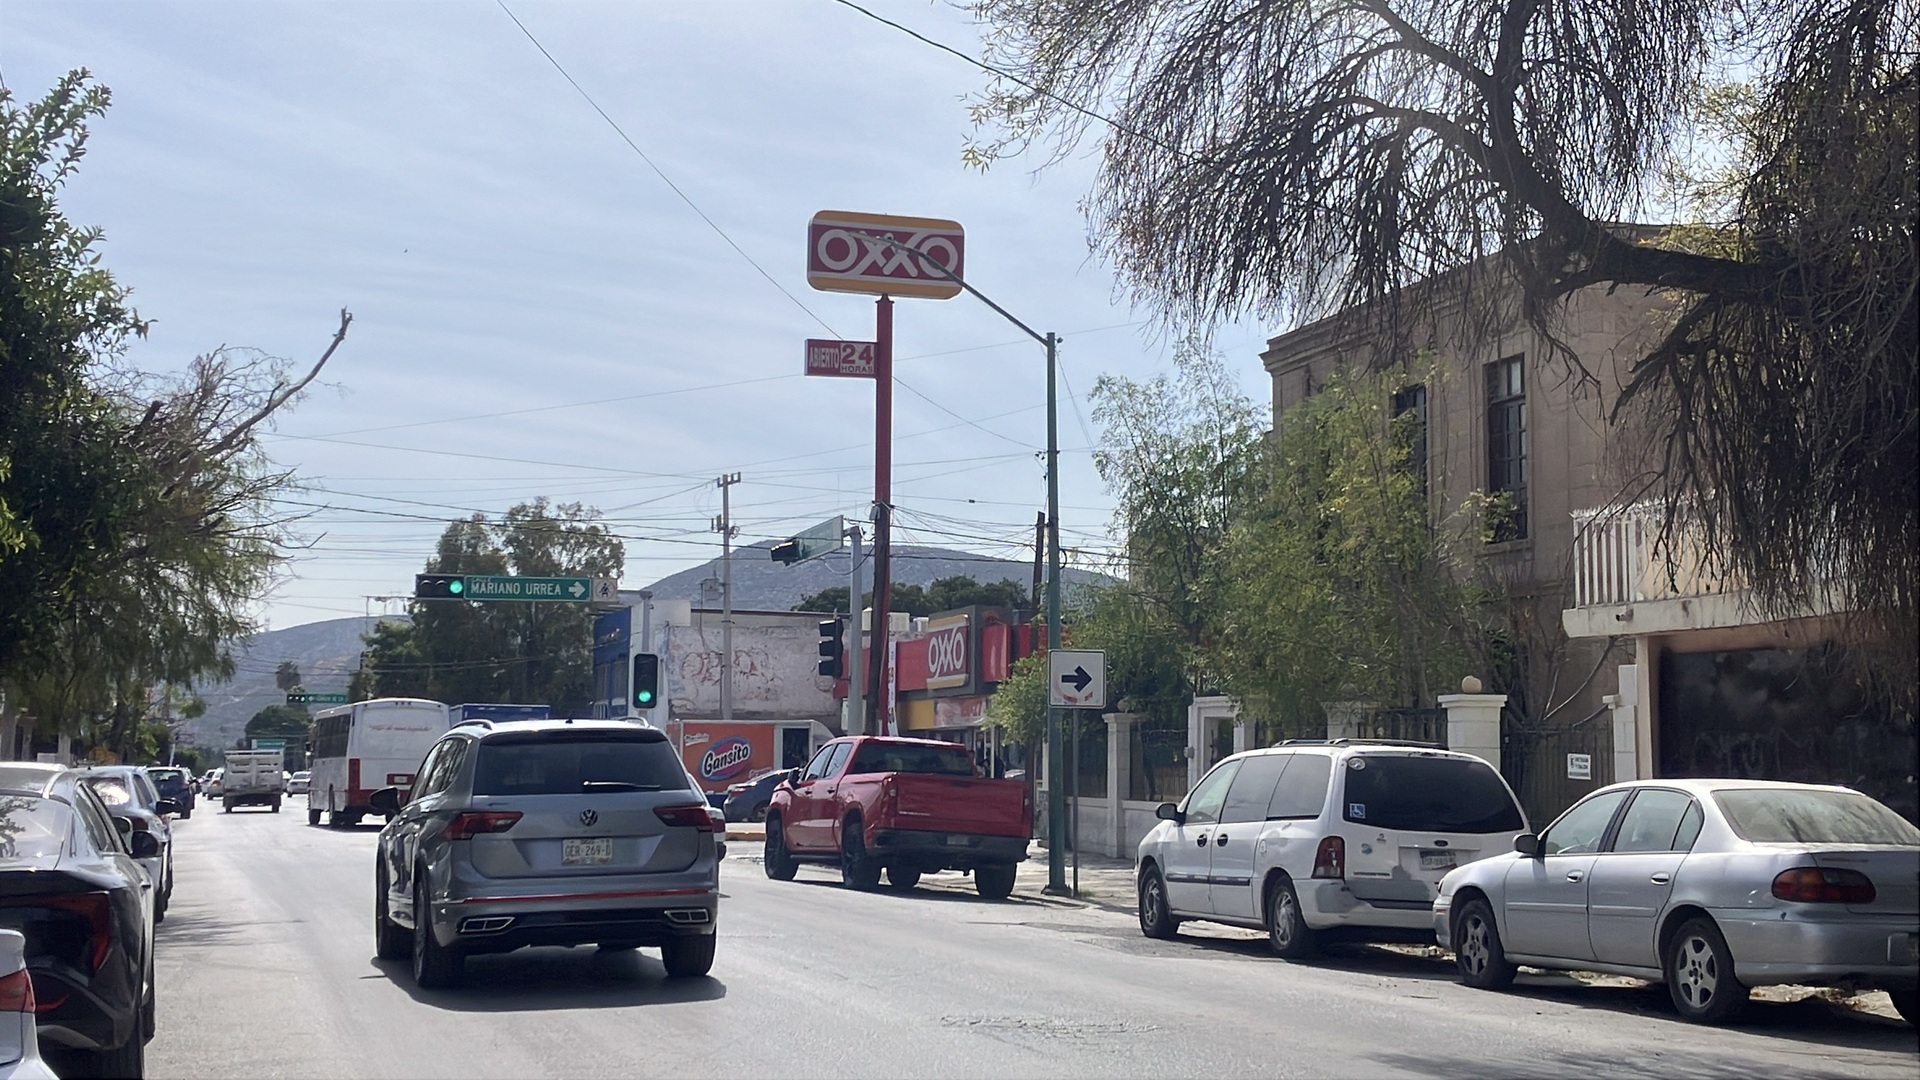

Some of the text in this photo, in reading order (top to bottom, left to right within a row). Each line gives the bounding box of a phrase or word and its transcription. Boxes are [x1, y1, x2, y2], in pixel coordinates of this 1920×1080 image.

[808, 344, 873, 369] ABIERTO 24
[841, 364, 873, 373] HORAS
[470, 582, 561, 596] MARIANO URREA
[928, 630, 965, 675] OXXO
[702, 743, 751, 777] Gansito
